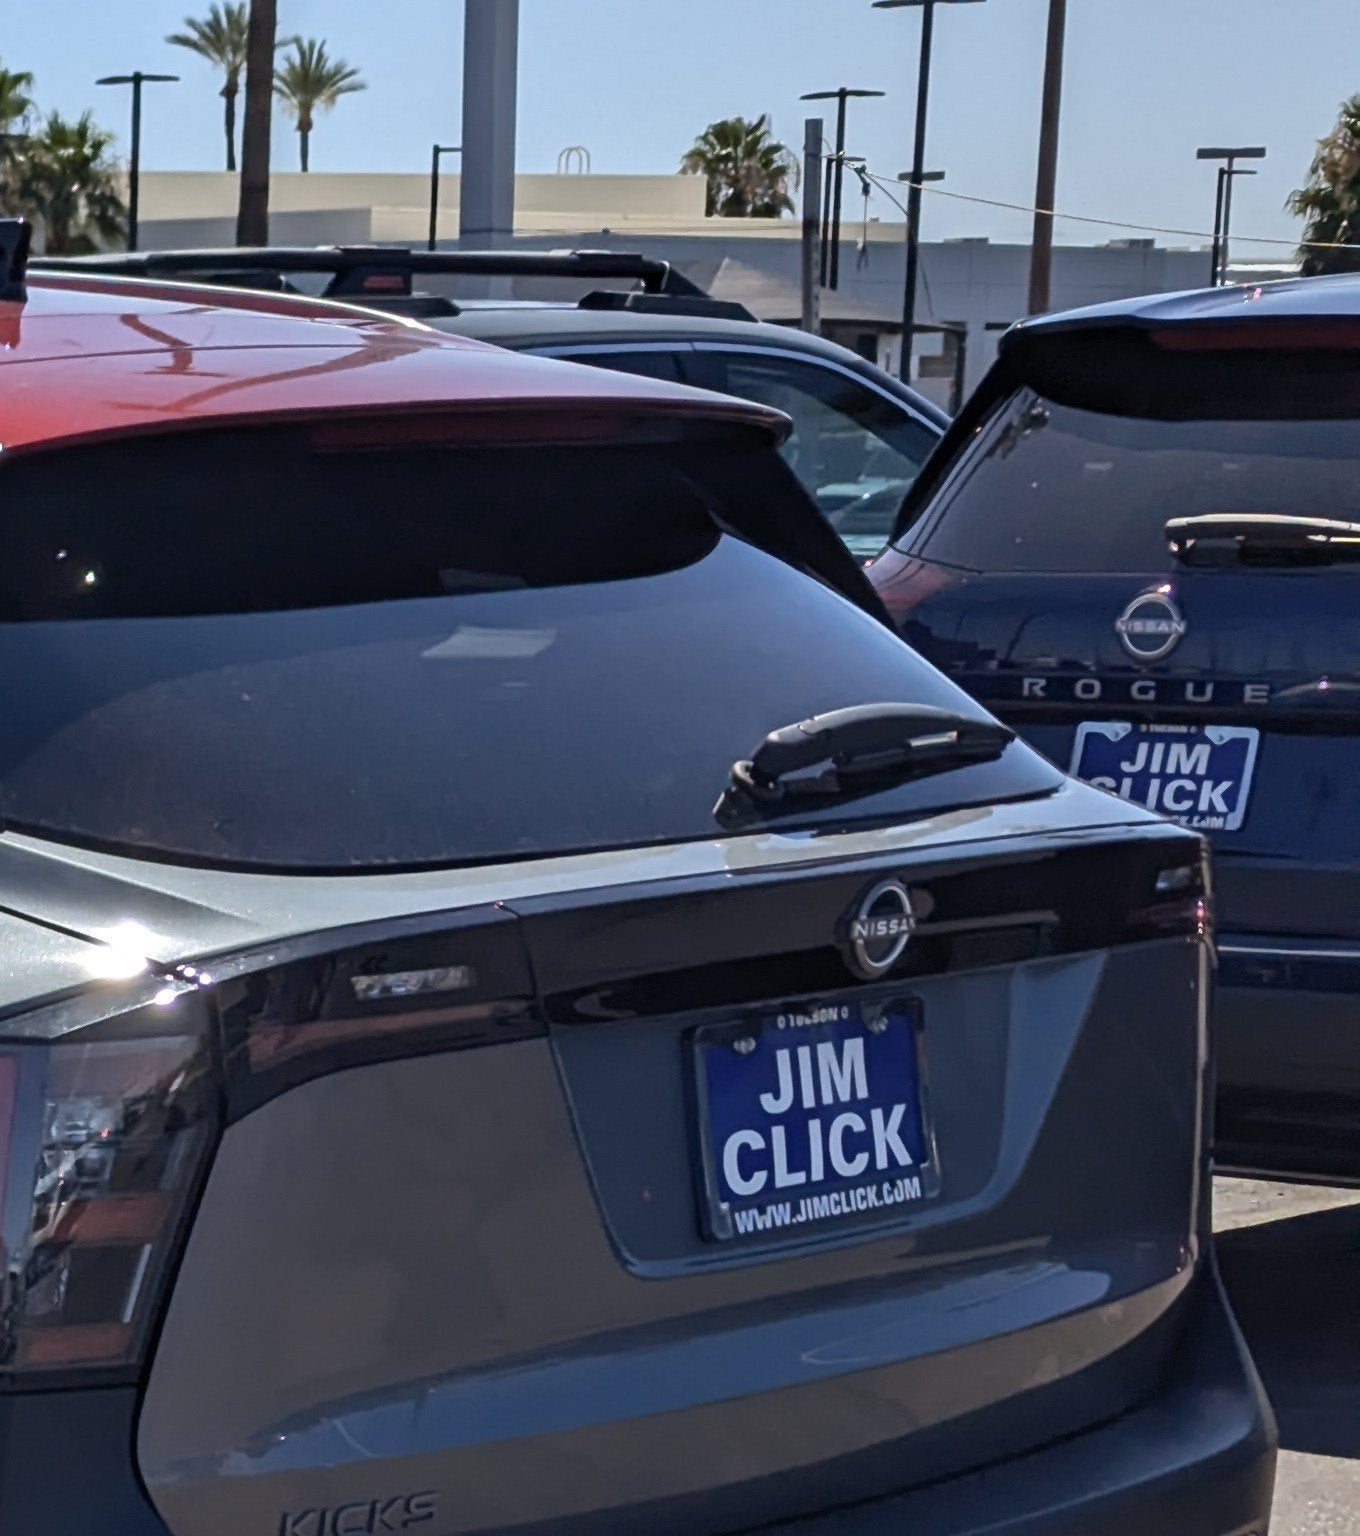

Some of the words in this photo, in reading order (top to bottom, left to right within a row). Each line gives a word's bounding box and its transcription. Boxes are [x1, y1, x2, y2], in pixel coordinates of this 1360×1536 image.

[1115, 618, 1186, 636] NISSAN
[1022, 677, 1270, 704] ROGUE
[1120, 741, 1211, 775] JIM
[759, 1036, 869, 1115] JIM
[722, 1103, 913, 1196] CLICK
[734, 1176, 923, 1234] WWW.JIMCLICK.COM
